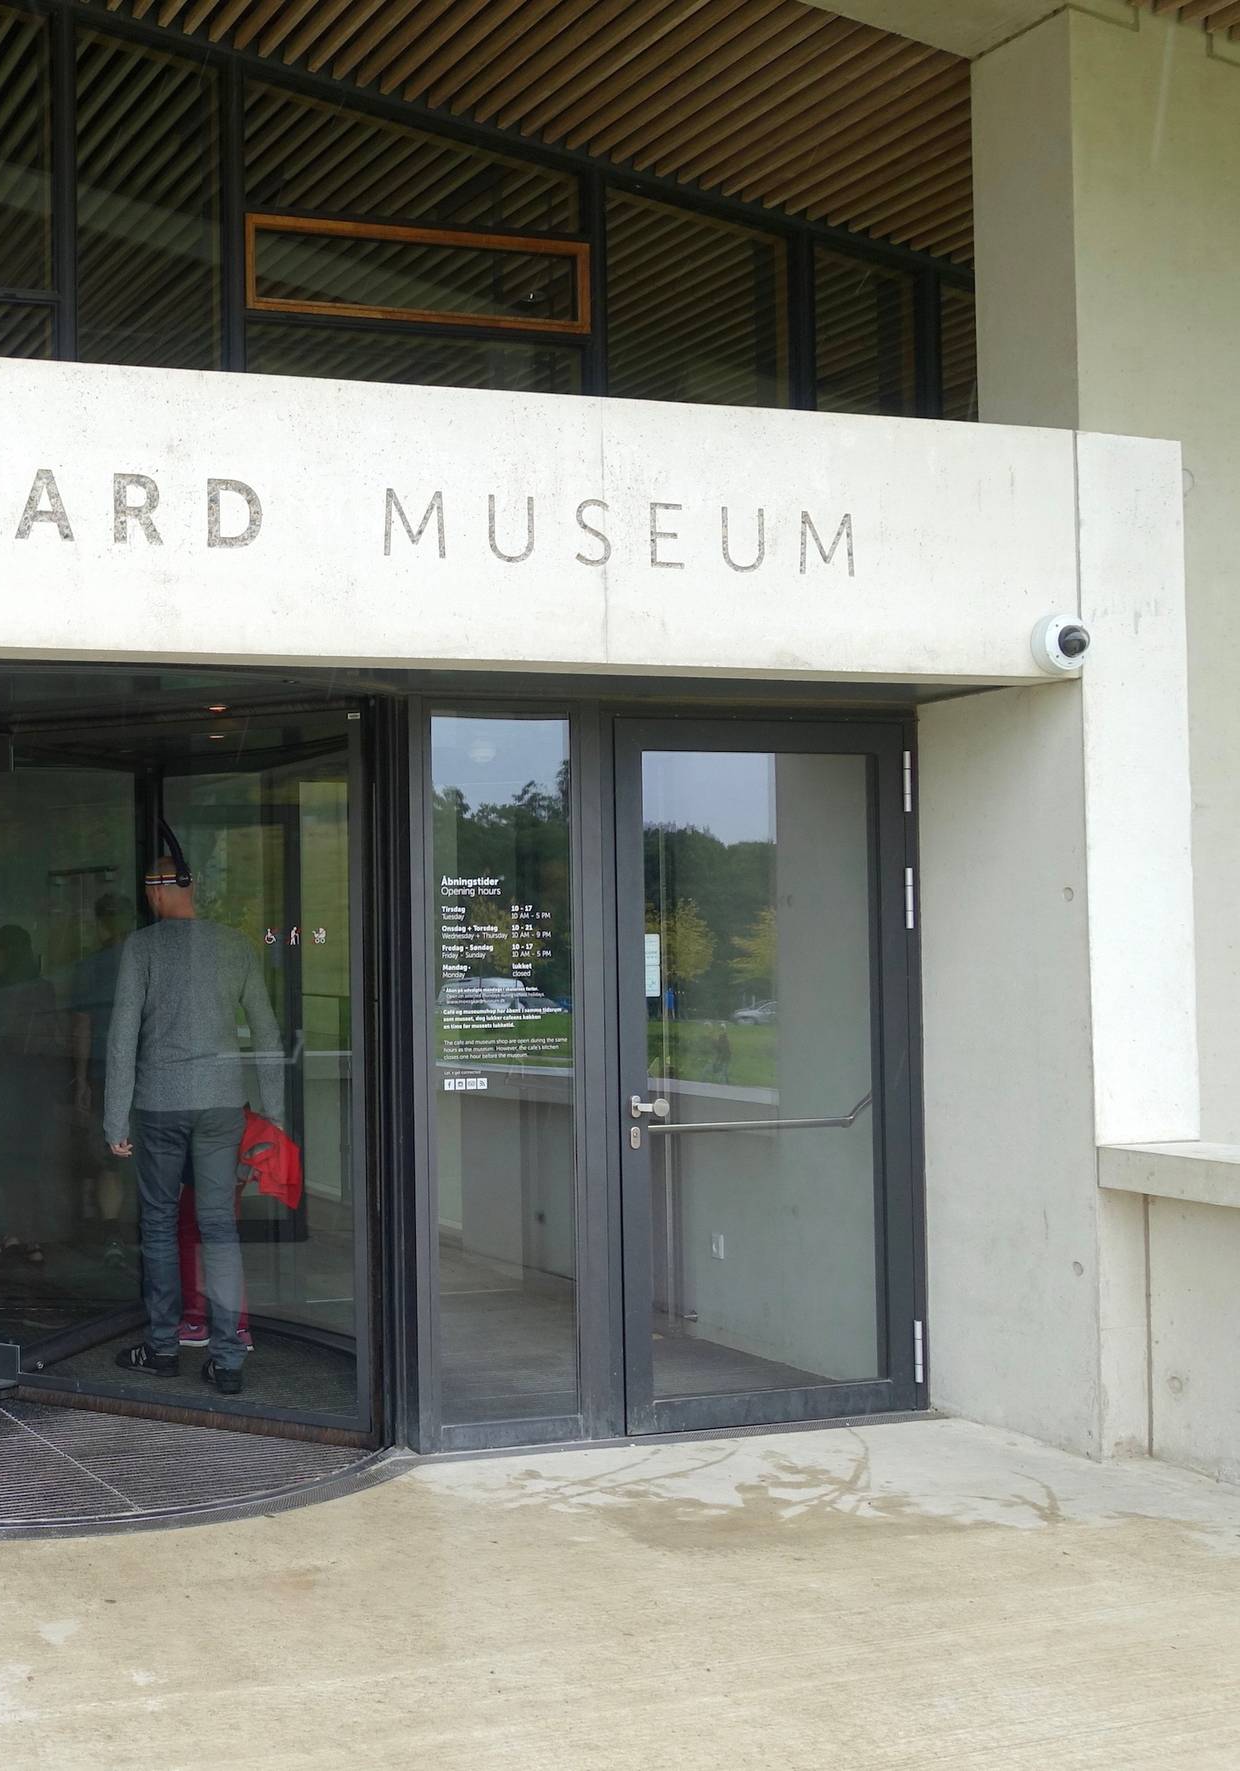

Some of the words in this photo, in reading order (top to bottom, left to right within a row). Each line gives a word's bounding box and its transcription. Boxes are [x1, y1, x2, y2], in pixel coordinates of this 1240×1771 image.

[383, 487, 855, 577] MUSEUM
[441, 875, 499, 888] Åbningstider
[441, 887, 475, 897] Opening
[478, 887, 501, 895] hours
[441, 913, 465, 921] Tuesday
[441, 925, 466, 933] Onsdag
[482, 932, 508, 940] Thursday
[442, 944, 464, 952] Fredag
[442, 952, 458, 960] Friday
[465, 951, 486, 960] Sunday
[442, 972, 465, 980] Monday
